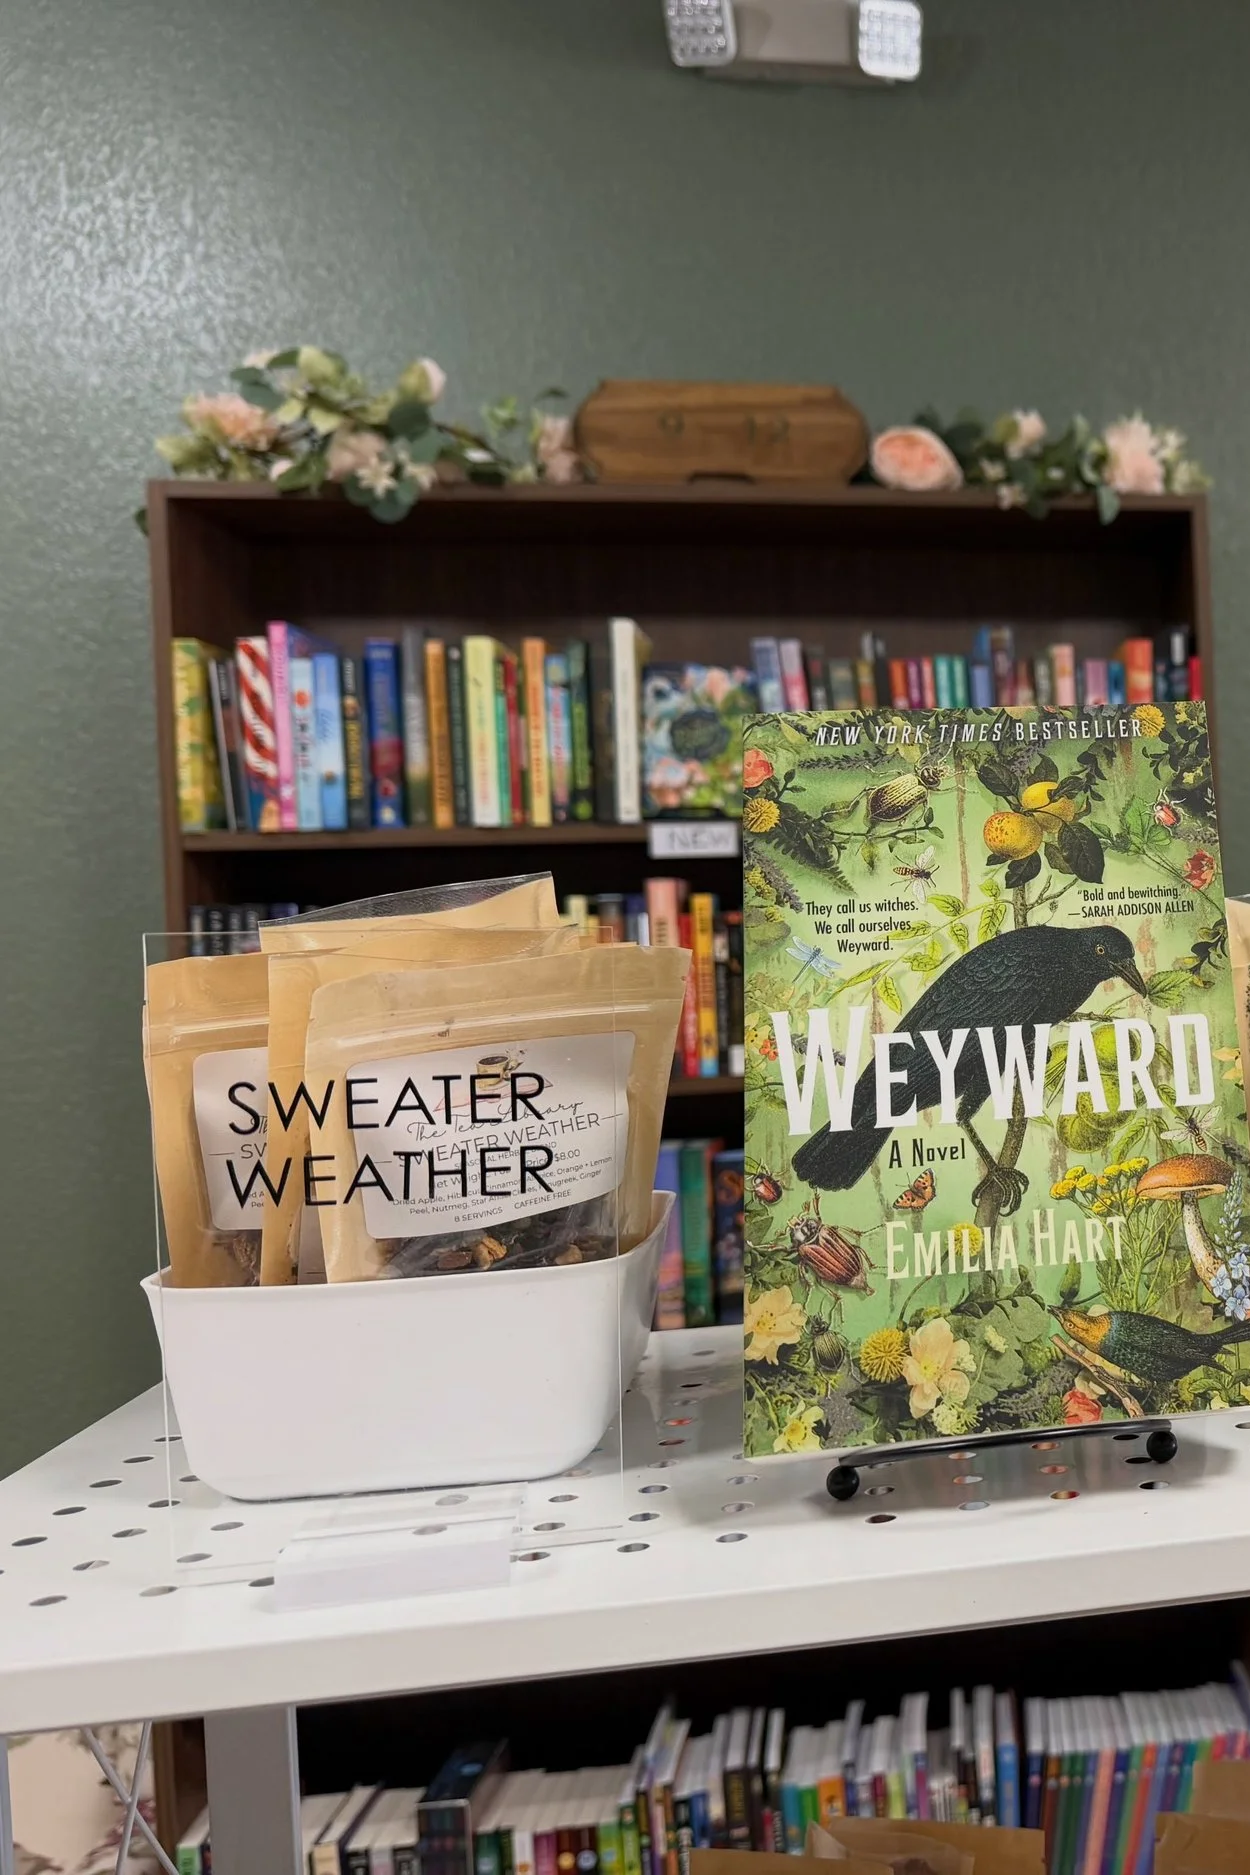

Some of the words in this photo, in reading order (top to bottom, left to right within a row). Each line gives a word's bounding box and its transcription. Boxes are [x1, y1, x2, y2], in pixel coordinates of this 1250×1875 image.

[815, 727, 861, 746] NEW
[875, 725, 925, 744] YORK
[939, 723, 1002, 742] TIMES
[1016, 719, 1142, 741] BESTSELLER
[669, 828, 731, 849] NEW
[1106, 889, 1126, 901] and
[806, 901, 832, 916] They
[836, 900, 856, 914] call
[858, 903, 872, 912] us
[874, 899, 919, 912] witches.
[1117, 903, 1163, 917] ADDISON
[1164, 900, 1195, 915] ALLEN
[814, 921, 832, 934] We
[836, 920, 856, 934] call
[837, 938, 894, 954] Weyward.
[228, 1071, 547, 1136] SWEATER
[407, 1121, 446, 1141] The
[451, 1114, 485, 1133] Tea
[489, 1102, 583, 1127] Lbary
[504, 1113, 600, 1145] WEATHER
[454, 1154, 497, 1170] SASOAL
[553, 1148, 581, 1162] $8.00
[888, 1140, 904, 1169] A
[911, 1137, 967, 1167] Novel
[557, 1164, 583, 1176] Orange
[590, 1155, 612, 1168] Lemon
[226, 1144, 554, 1209] WEATHER
[471, 1198, 488, 1207] Star
[580, 1168, 602, 1182] Ginger
[514, 1194, 551, 1210] CAFFEINE
[553, 1188, 572, 1199] FREE
[462, 1206, 504, 1222] SERVINGS
